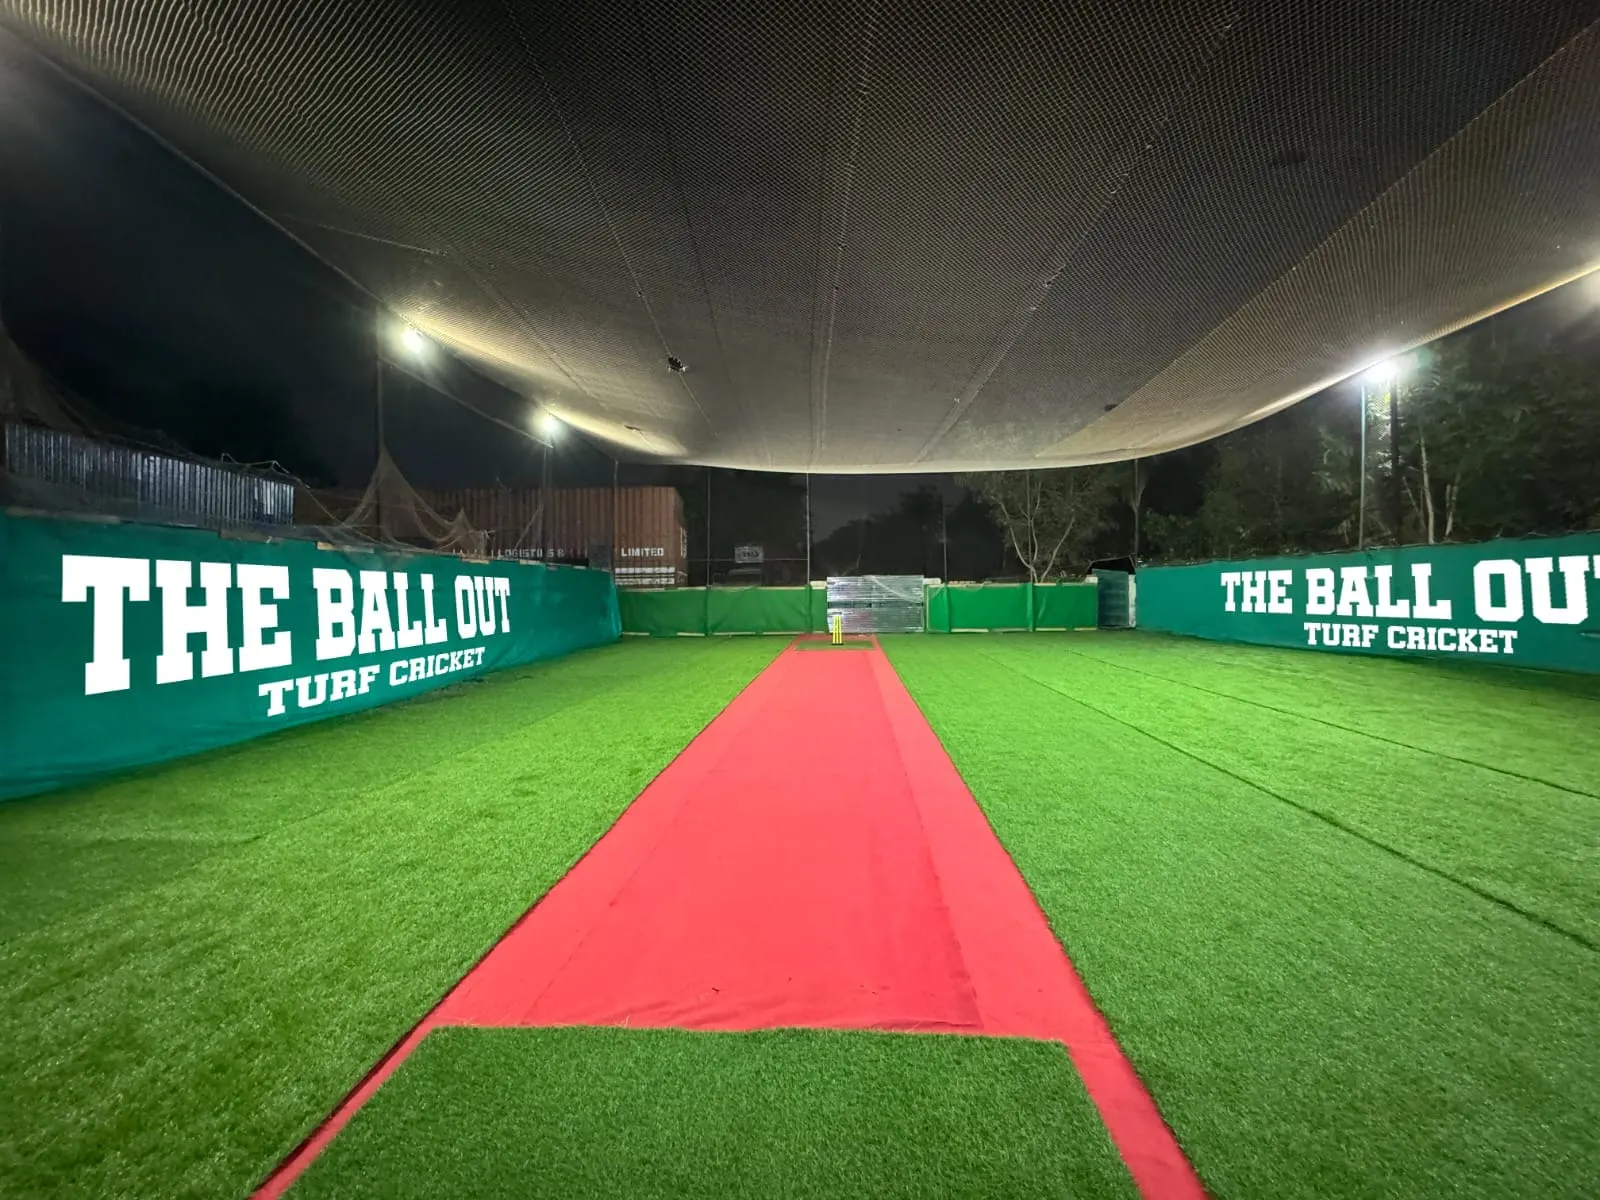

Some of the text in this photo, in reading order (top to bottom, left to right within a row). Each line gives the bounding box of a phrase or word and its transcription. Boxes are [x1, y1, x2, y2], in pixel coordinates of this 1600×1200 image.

[621, 547, 665, 557] LIMITED
[1221, 555, 1600, 624] THE BALL OU
[62, 555, 510, 695] THE BALL OUT
[1304, 623, 1518, 654] TURF CRICKET
[259, 647, 485, 716] TURF CRICKET
